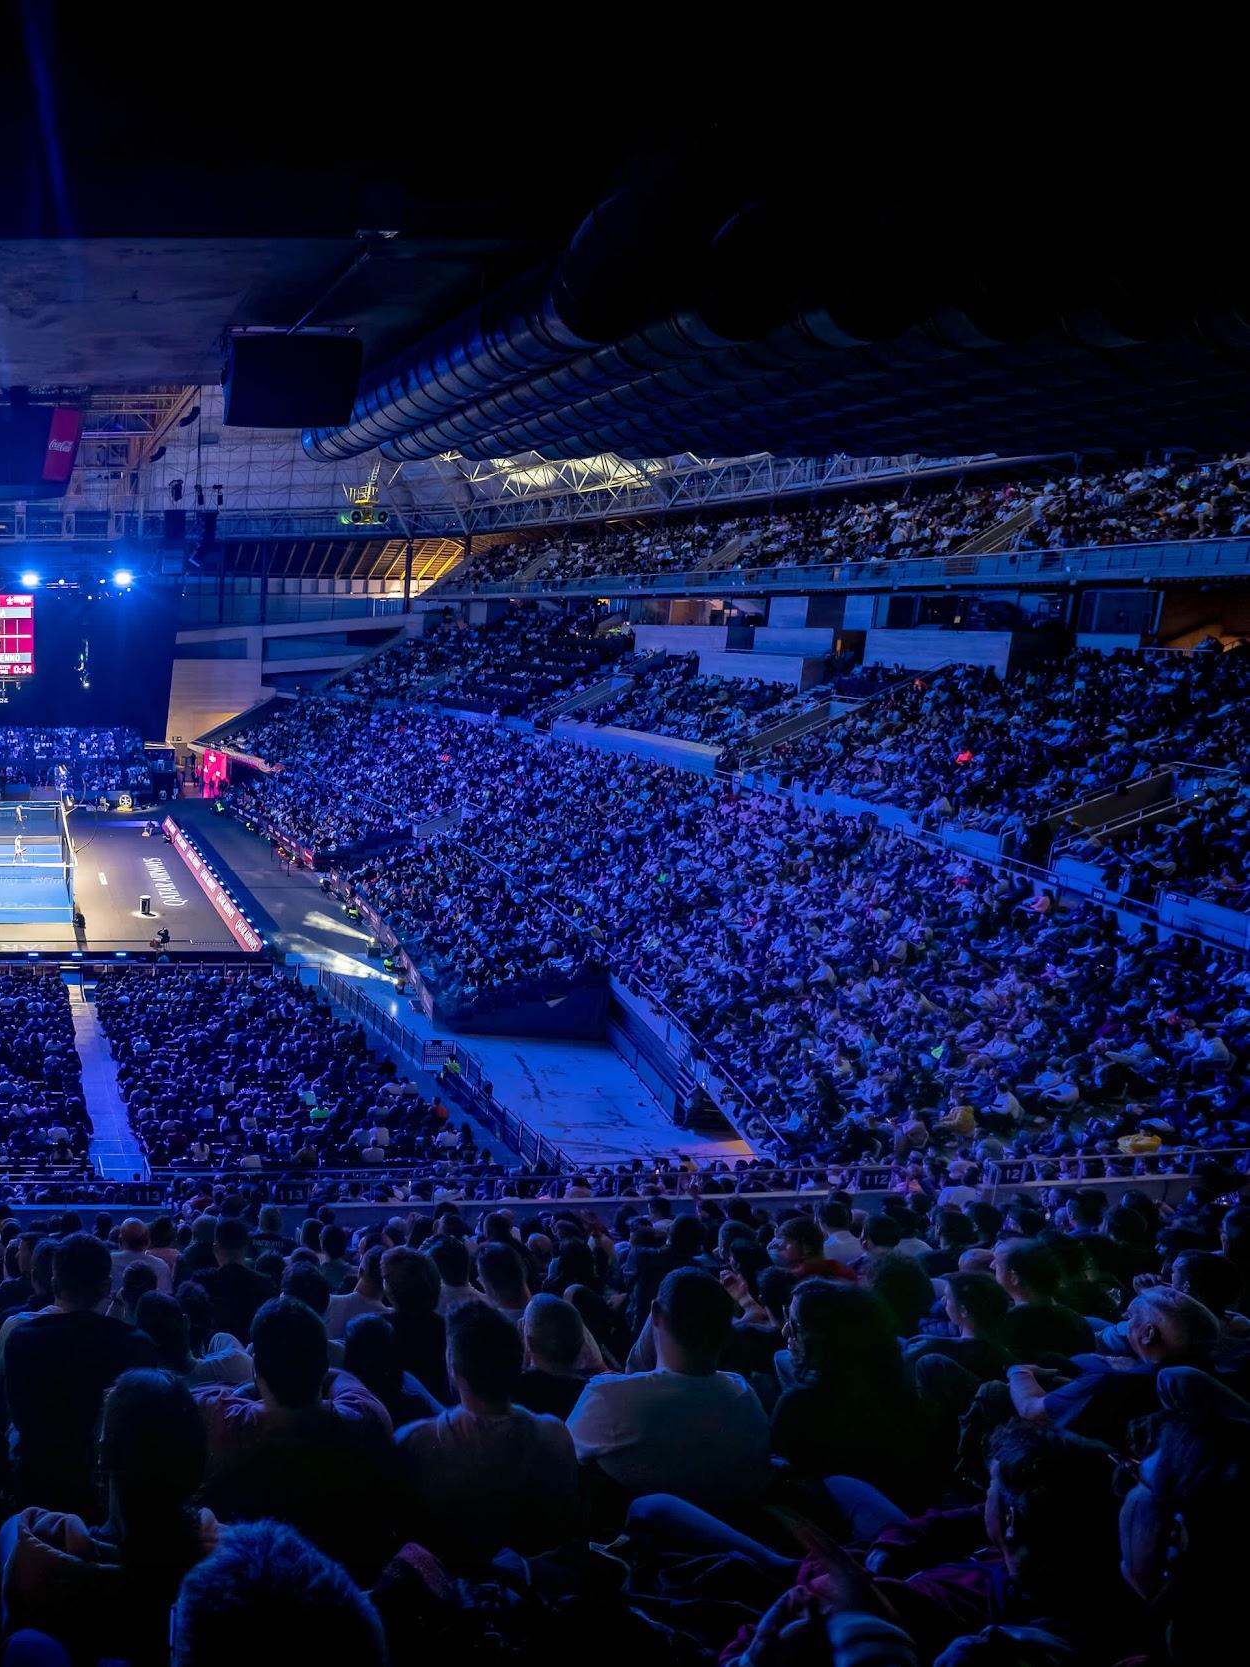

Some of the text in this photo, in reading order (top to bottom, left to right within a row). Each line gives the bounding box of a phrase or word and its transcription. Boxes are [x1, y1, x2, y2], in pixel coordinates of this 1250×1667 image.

[48, 438, 74, 453] Coca-Cola
[13, 665, 32, 674] 0:34
[154, 880, 188, 906] QATAR
[865, 1174, 889, 1186] 112
[137, 1190, 160, 1200] 113
[280, 1189, 302, 1201] 113
